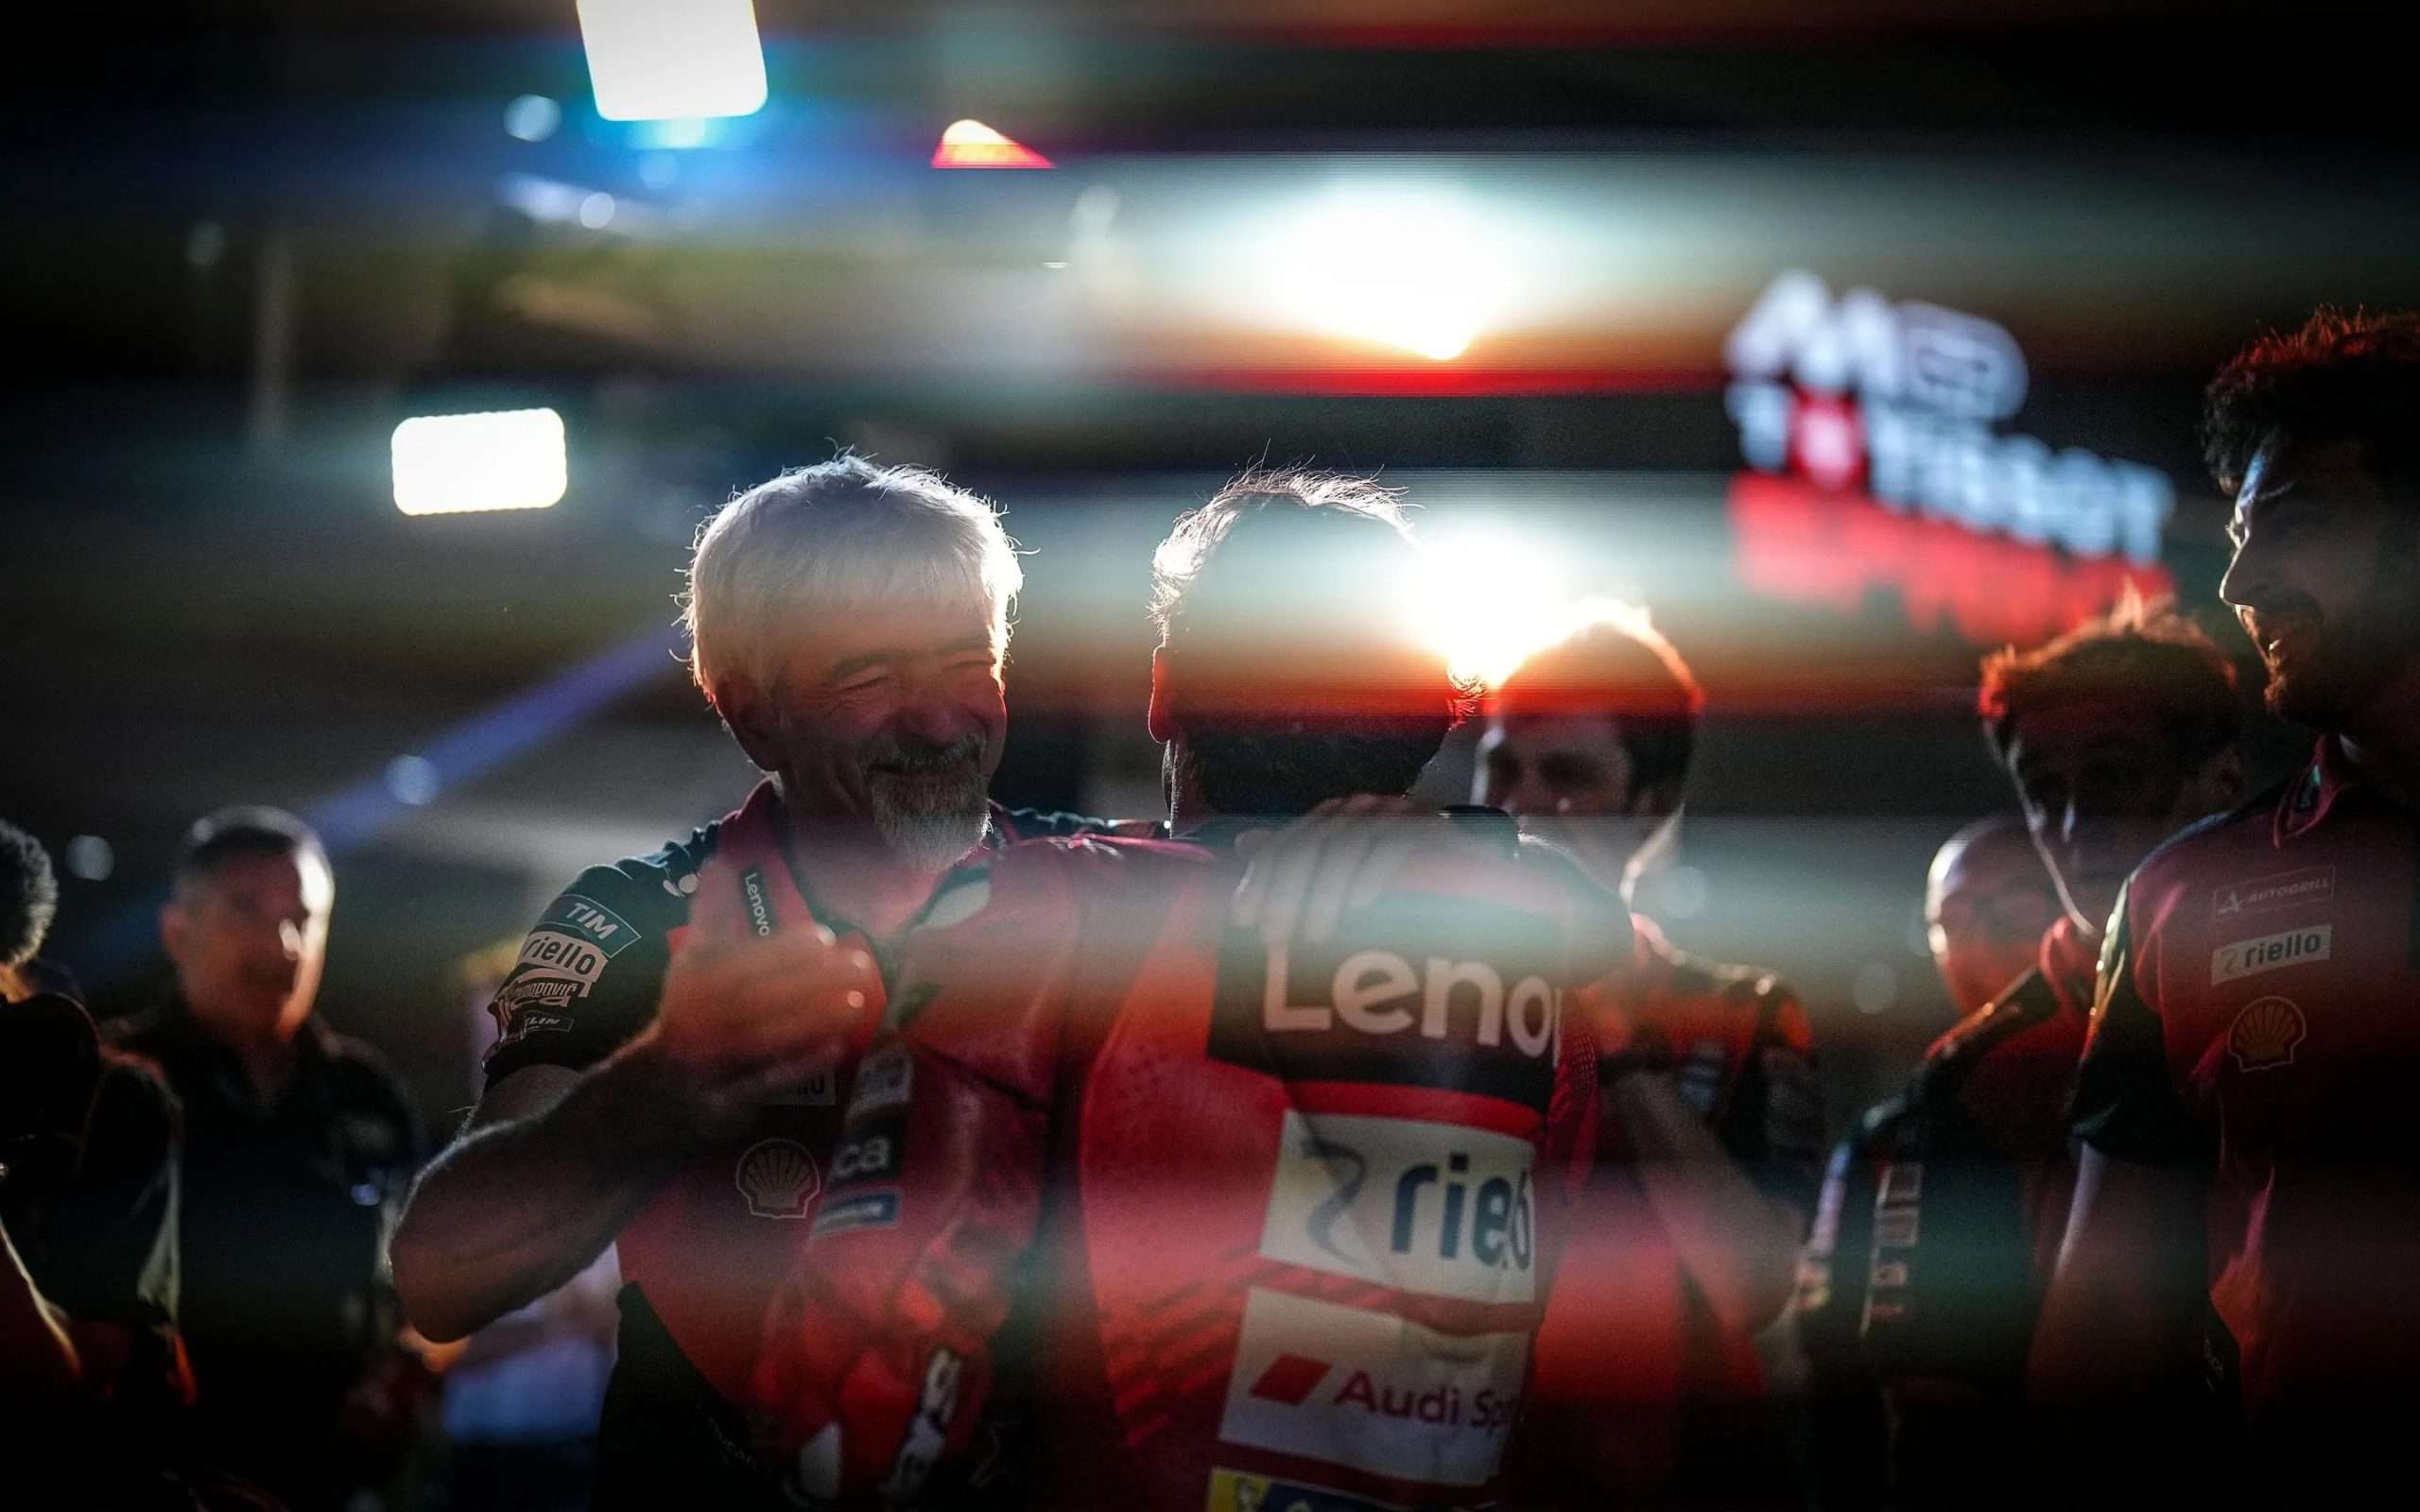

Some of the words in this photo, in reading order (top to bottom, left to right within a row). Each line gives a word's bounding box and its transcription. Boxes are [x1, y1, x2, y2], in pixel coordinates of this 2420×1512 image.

[566, 902, 619, 940] TIM
[745, 872, 770, 936] Lenovo
[523, 936, 596, 975] riello
[2244, 934, 2322, 968] riello
[1264, 930, 1563, 1069] Leno
[1334, 1371, 1460, 1425] Audi
